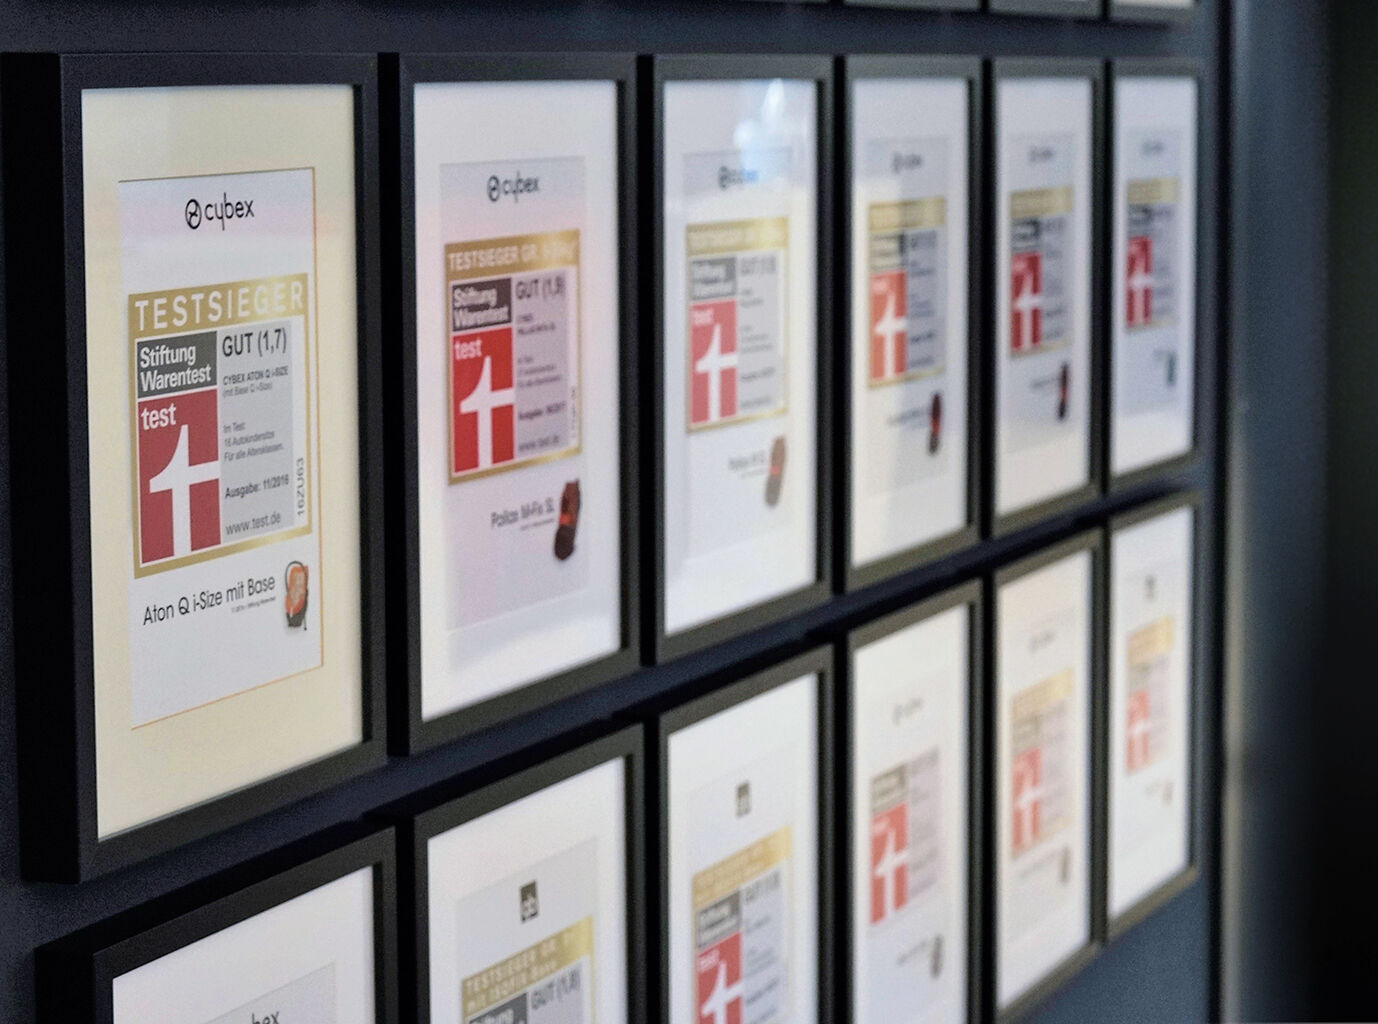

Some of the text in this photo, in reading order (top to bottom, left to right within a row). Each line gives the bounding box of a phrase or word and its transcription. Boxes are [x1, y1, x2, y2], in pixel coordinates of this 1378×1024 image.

[204, 192, 255, 231] cybex
[448, 245, 519, 272] TESTSIEGER
[134, 281, 304, 331] TESTSIEGER
[139, 344, 197, 368] Stiftung
[222, 327, 287, 358] GUT (1,7)
[139, 363, 212, 392] Warentest
[141, 403, 177, 431] test
[225, 481, 261, 499] Ausgabe:
[225, 511, 281, 535] www.test.de
[143, 604, 175, 626] Aton
[178, 596, 190, 616] Q
[193, 590, 223, 612] i-Size
[226, 581, 244, 602] mit
[247, 576, 276, 596] Base
